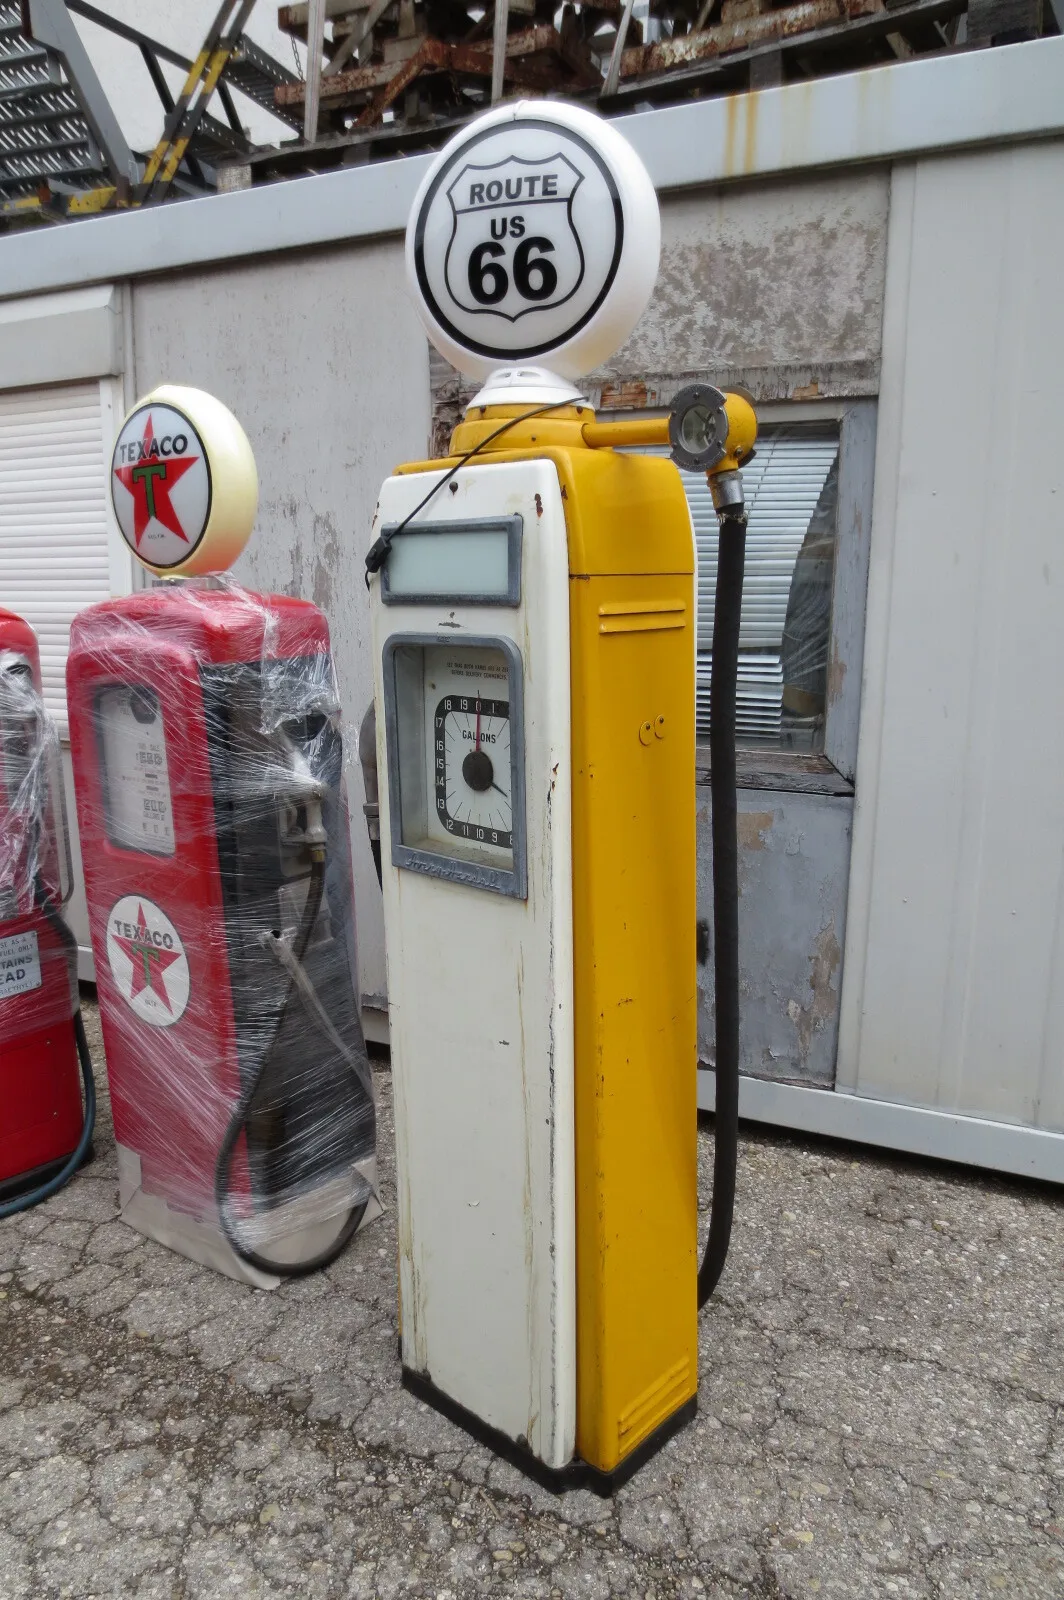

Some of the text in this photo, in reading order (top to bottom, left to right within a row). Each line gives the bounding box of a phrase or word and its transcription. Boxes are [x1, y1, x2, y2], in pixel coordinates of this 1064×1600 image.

[469, 174, 558, 205] ROUTE
[490, 215, 526, 240] US
[468, 236, 558, 305] 66
[119, 433, 189, 464] TEXACO
[132, 462, 167, 519] T
[444, 699, 452, 711] 18
[460, 699, 468, 711] 19
[435, 717, 444, 728] 17
[462, 730, 496, 744] GALONS
[436, 740, 444, 750] 16
[436, 758, 444, 769] 15
[436, 776, 444, 786] 14
[437, 798, 445, 809] 13
[446, 820, 454, 831] 12
[462, 825, 469, 836] 11
[476, 828, 484, 839] 10
[491, 832, 498, 843] 9
[113, 919, 174, 949] TEXACO
[18, 943, 33, 952] ONLY
[1, 954, 33, 970] TAINS
[132, 942, 161, 987] T
